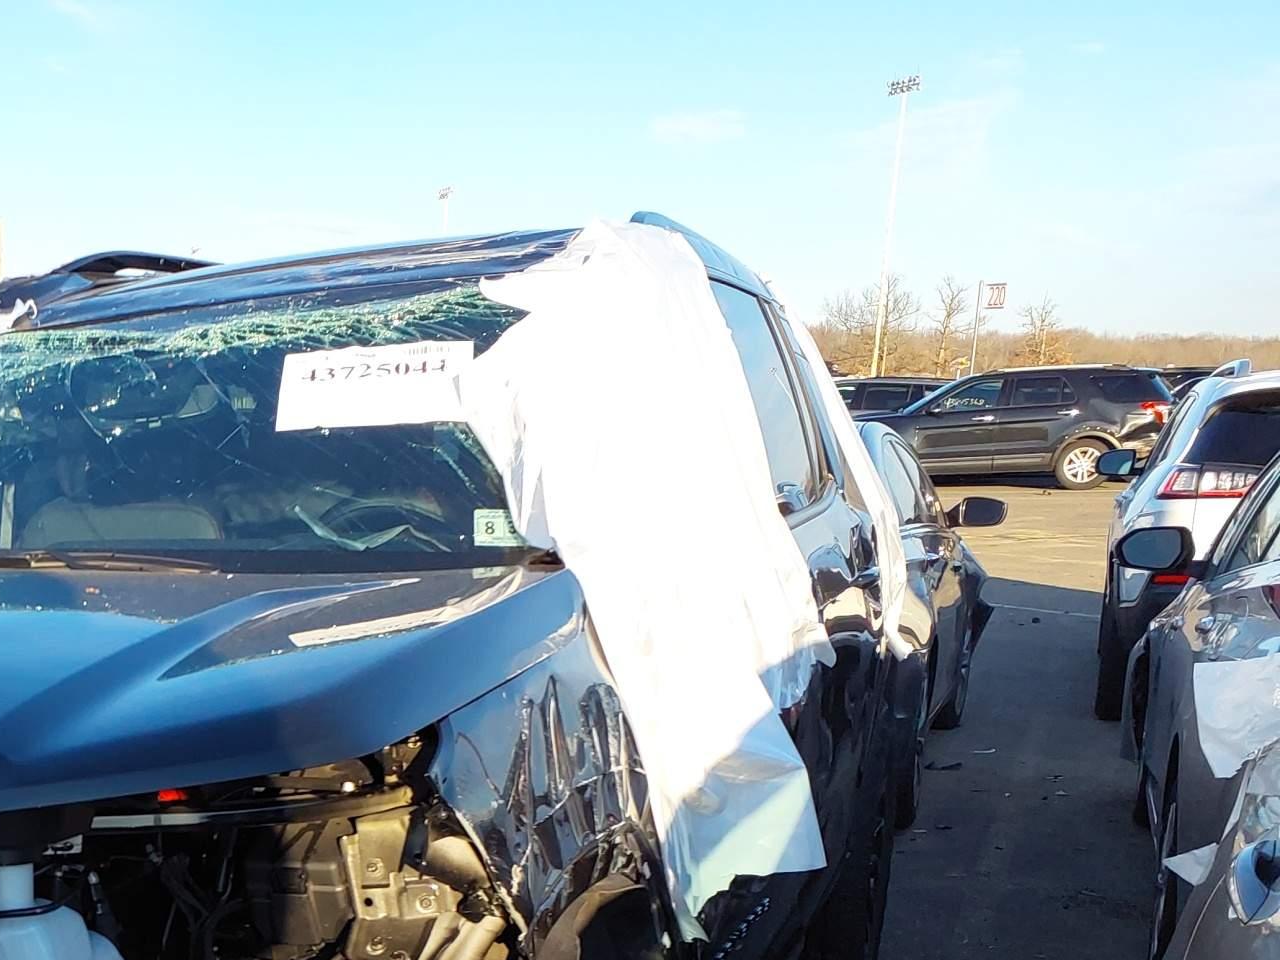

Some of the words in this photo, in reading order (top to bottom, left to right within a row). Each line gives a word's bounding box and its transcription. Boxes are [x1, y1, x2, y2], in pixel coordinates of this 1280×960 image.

[987, 286, 1006, 306] 220
[301, 359, 448, 382] 43725044
[485, 521, 495, 535] 8
